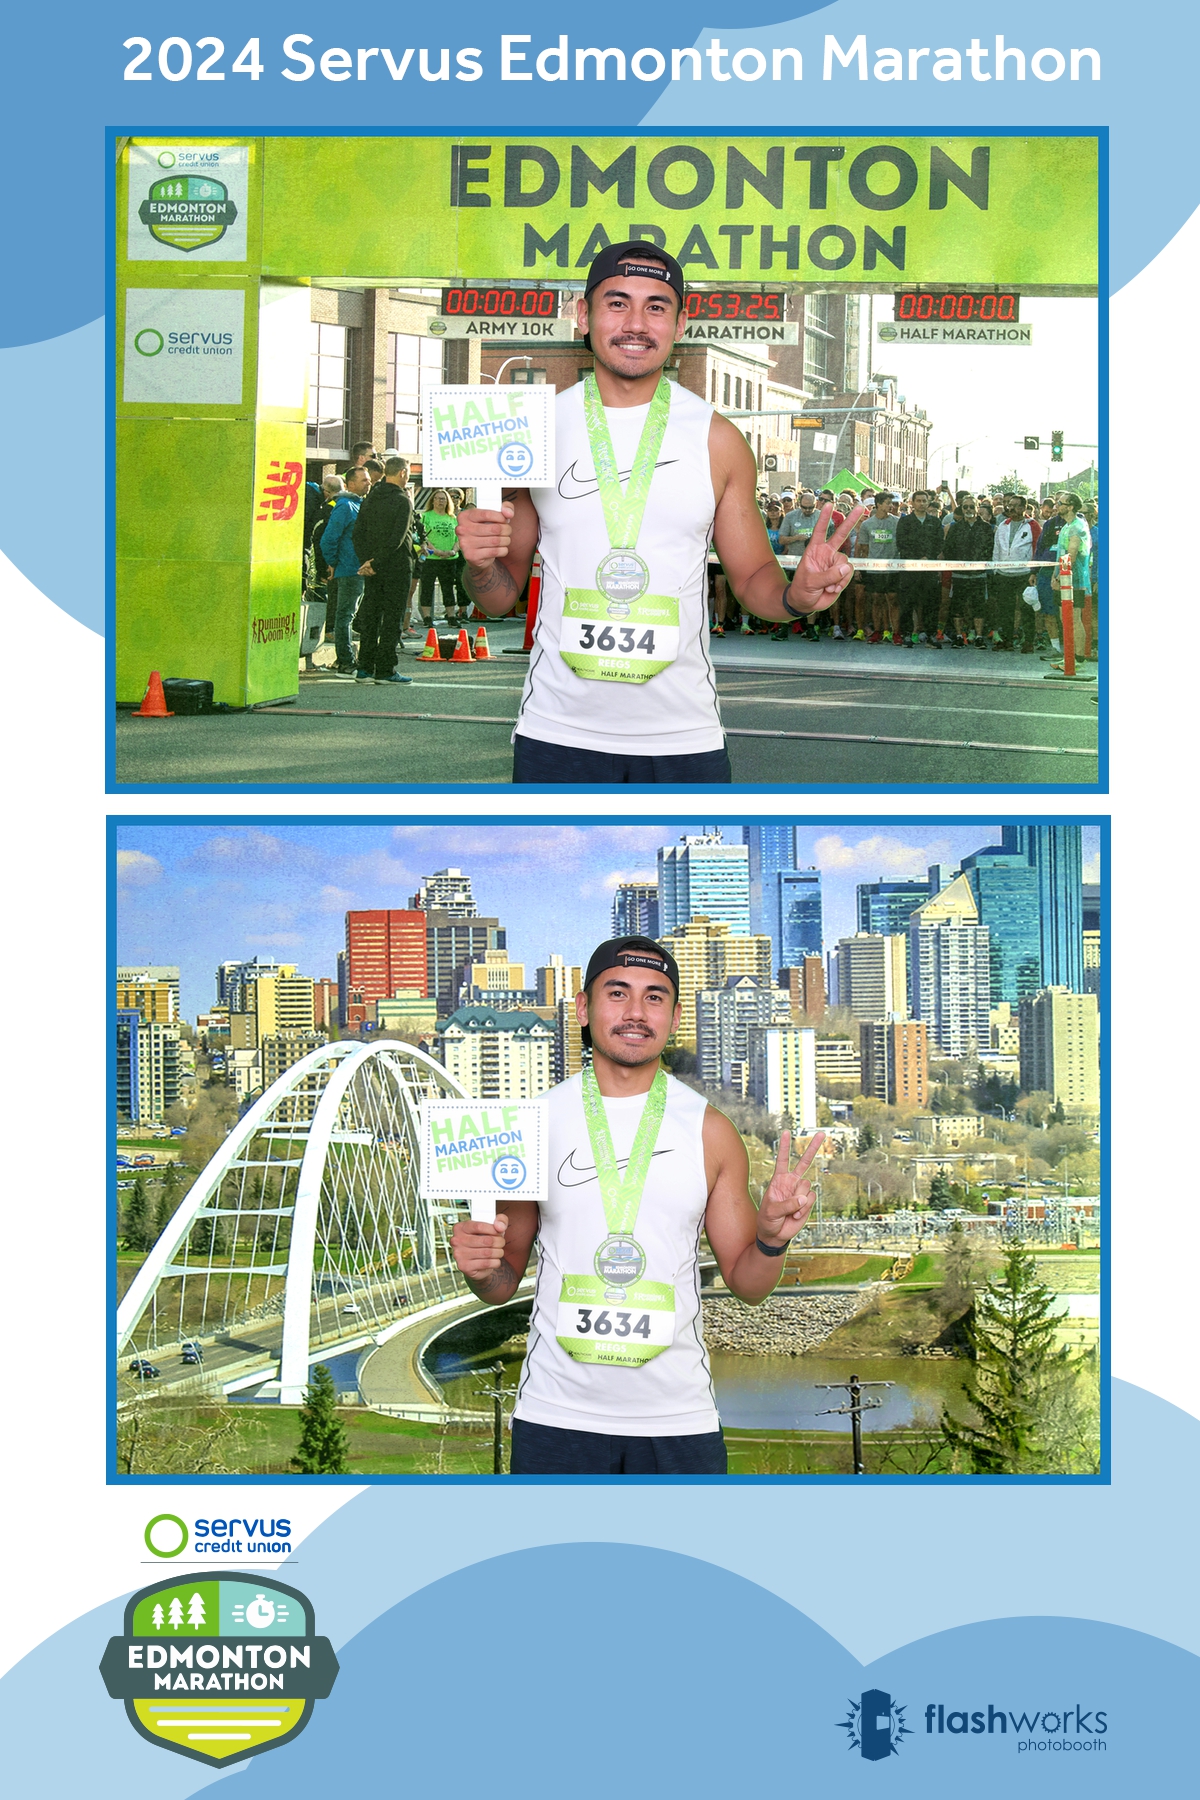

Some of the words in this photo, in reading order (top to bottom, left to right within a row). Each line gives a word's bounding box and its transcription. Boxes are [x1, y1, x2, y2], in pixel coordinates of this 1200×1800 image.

[178, 152, 220, 161] servus
[449, 144, 991, 211] EDMONTON
[149, 202, 227, 214] EDMONTON
[160, 214, 216, 222] MARATHON
[648, 268, 664, 276] MORE
[465, 321, 518, 336] ARMY
[521, 322, 554, 336] 10K
[900, 328, 939, 340] HALF
[942, 328, 1031, 341] MARATHON
[168, 331, 233, 345] servus
[168, 345, 200, 355] credit
[202, 347, 233, 355] union
[432, 391, 524, 432] HALF
[437, 415, 529, 445] MARATHON
[439, 429, 533, 461] FINISHER!
[257, 613, 291, 635] Running
[579, 623, 656, 655] 3634
[598, 658, 631, 669] REEGS
[600, 670, 618, 678] HALF
[619, 672, 657, 680] MARATHO
[647, 959, 662, 967] MORE
[430, 1105, 519, 1145] HALF
[434, 1129, 523, 1157] MARATHON
[436, 1143, 526, 1173] FINISHER!
[575, 1308, 651, 1339] 3634
[594, 1342, 627, 1353] REEGS
[615, 1355, 653, 1364] MARATHO
